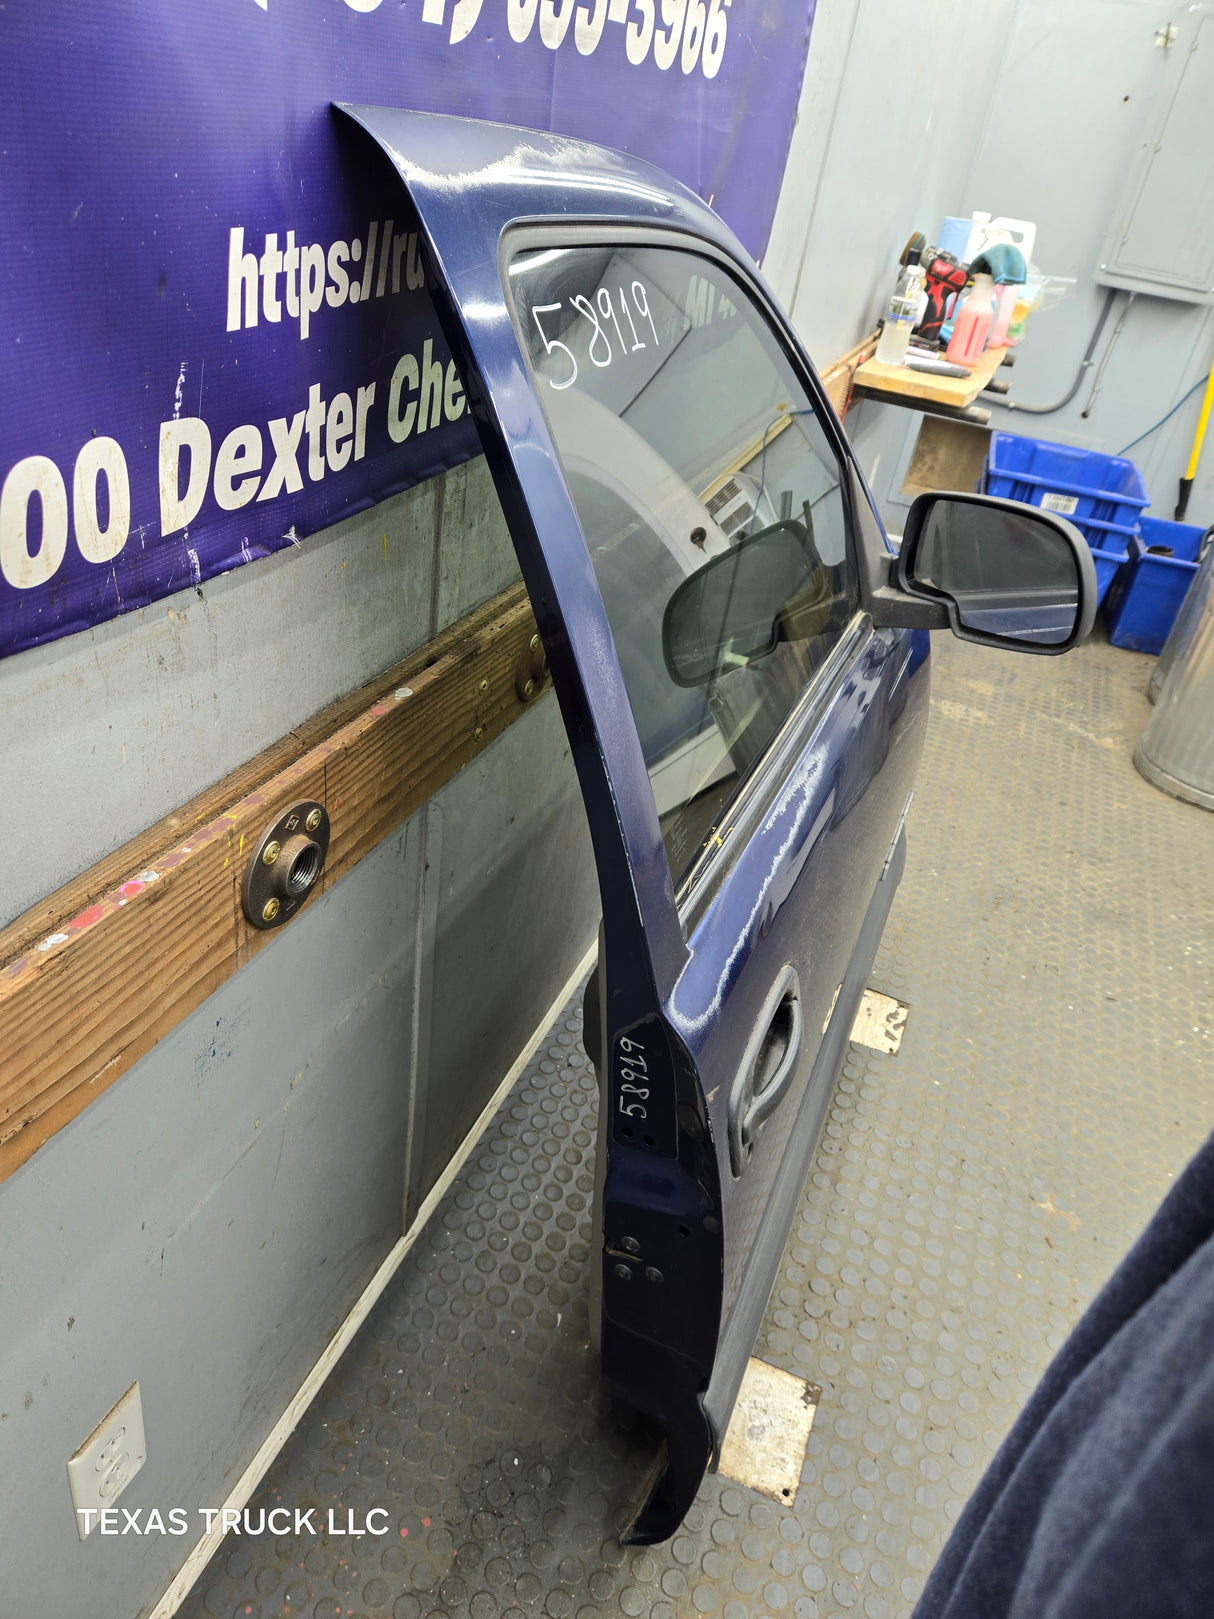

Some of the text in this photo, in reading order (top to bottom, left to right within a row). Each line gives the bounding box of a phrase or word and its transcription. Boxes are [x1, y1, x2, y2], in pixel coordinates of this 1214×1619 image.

[532, 281, 659, 390] 58919
[159, 381, 376, 538] Dexter
[387, 338, 473, 443] Che
[619, 1036, 650, 1119] 58919
